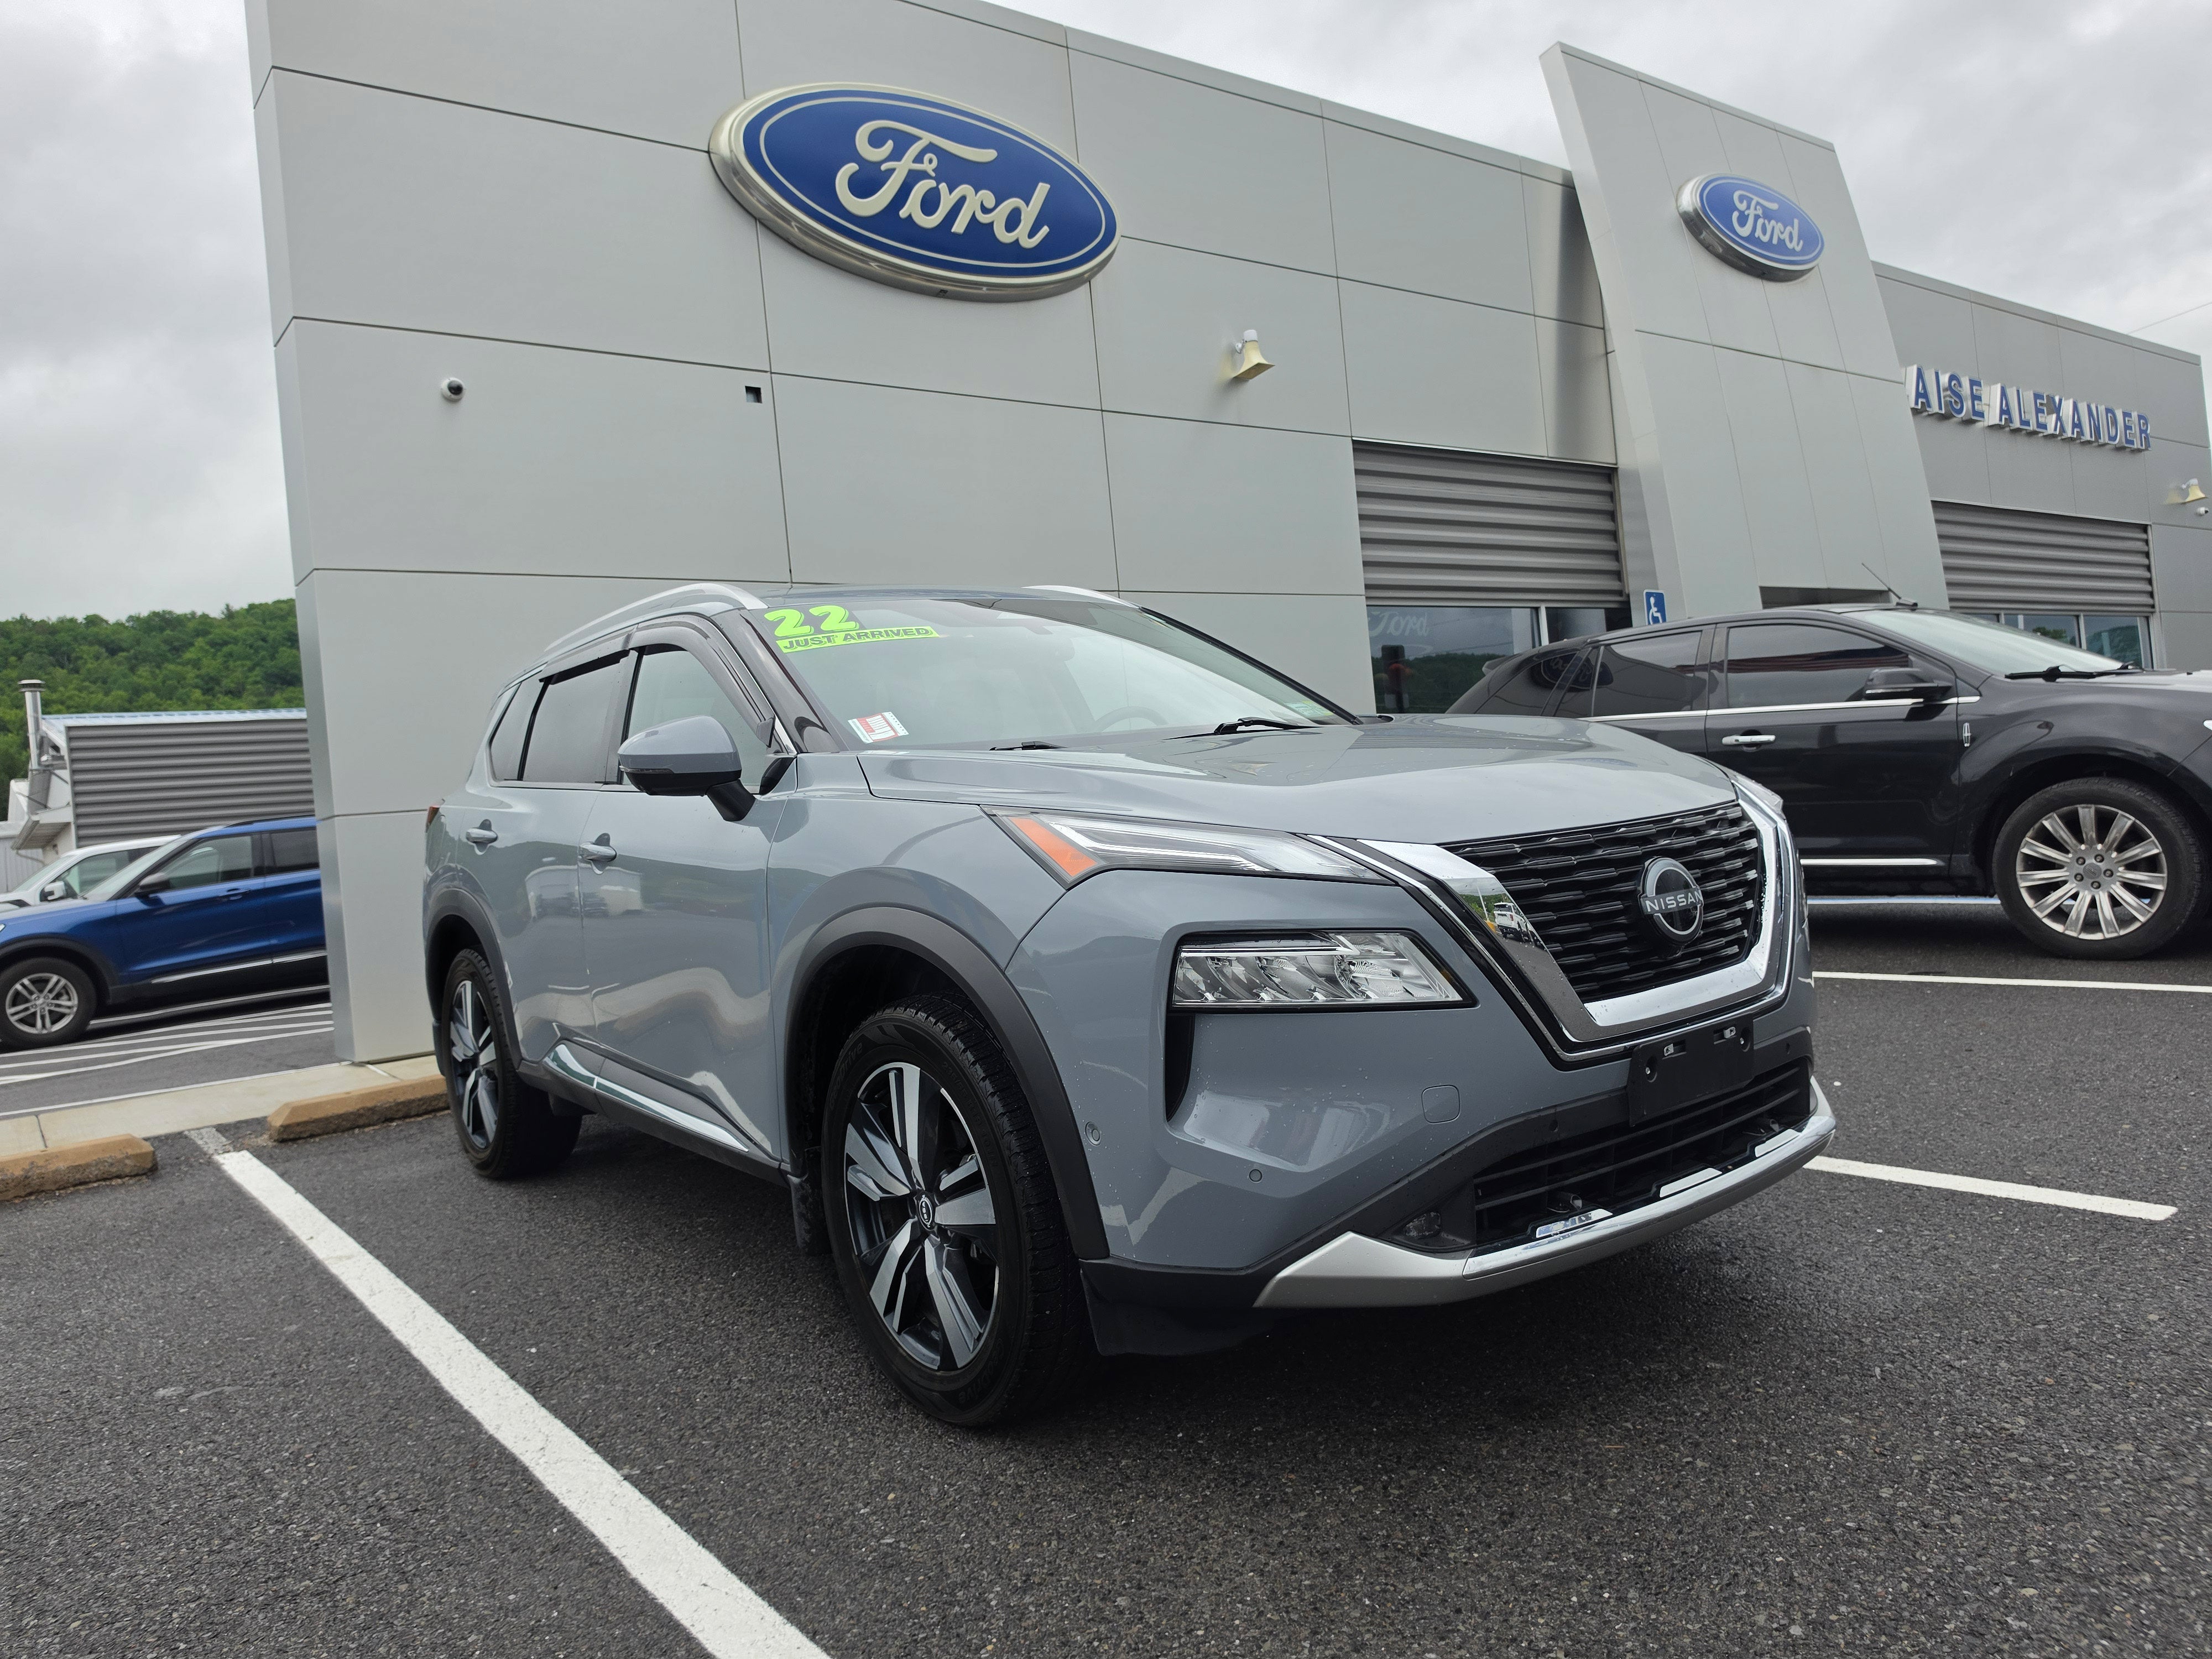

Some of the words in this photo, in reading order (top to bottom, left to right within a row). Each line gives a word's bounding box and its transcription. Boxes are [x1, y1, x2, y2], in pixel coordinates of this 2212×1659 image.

[835, 119, 1051, 249] Ford
[1731, 190, 1803, 252] Ford
[1997, 382, 2152, 450] ALEXANDER
[764, 604, 860, 638] 22
[783, 634, 837, 650] JUST
[842, 627, 934, 642] ARRIVED
[1645, 889, 1703, 912] NISSAN
